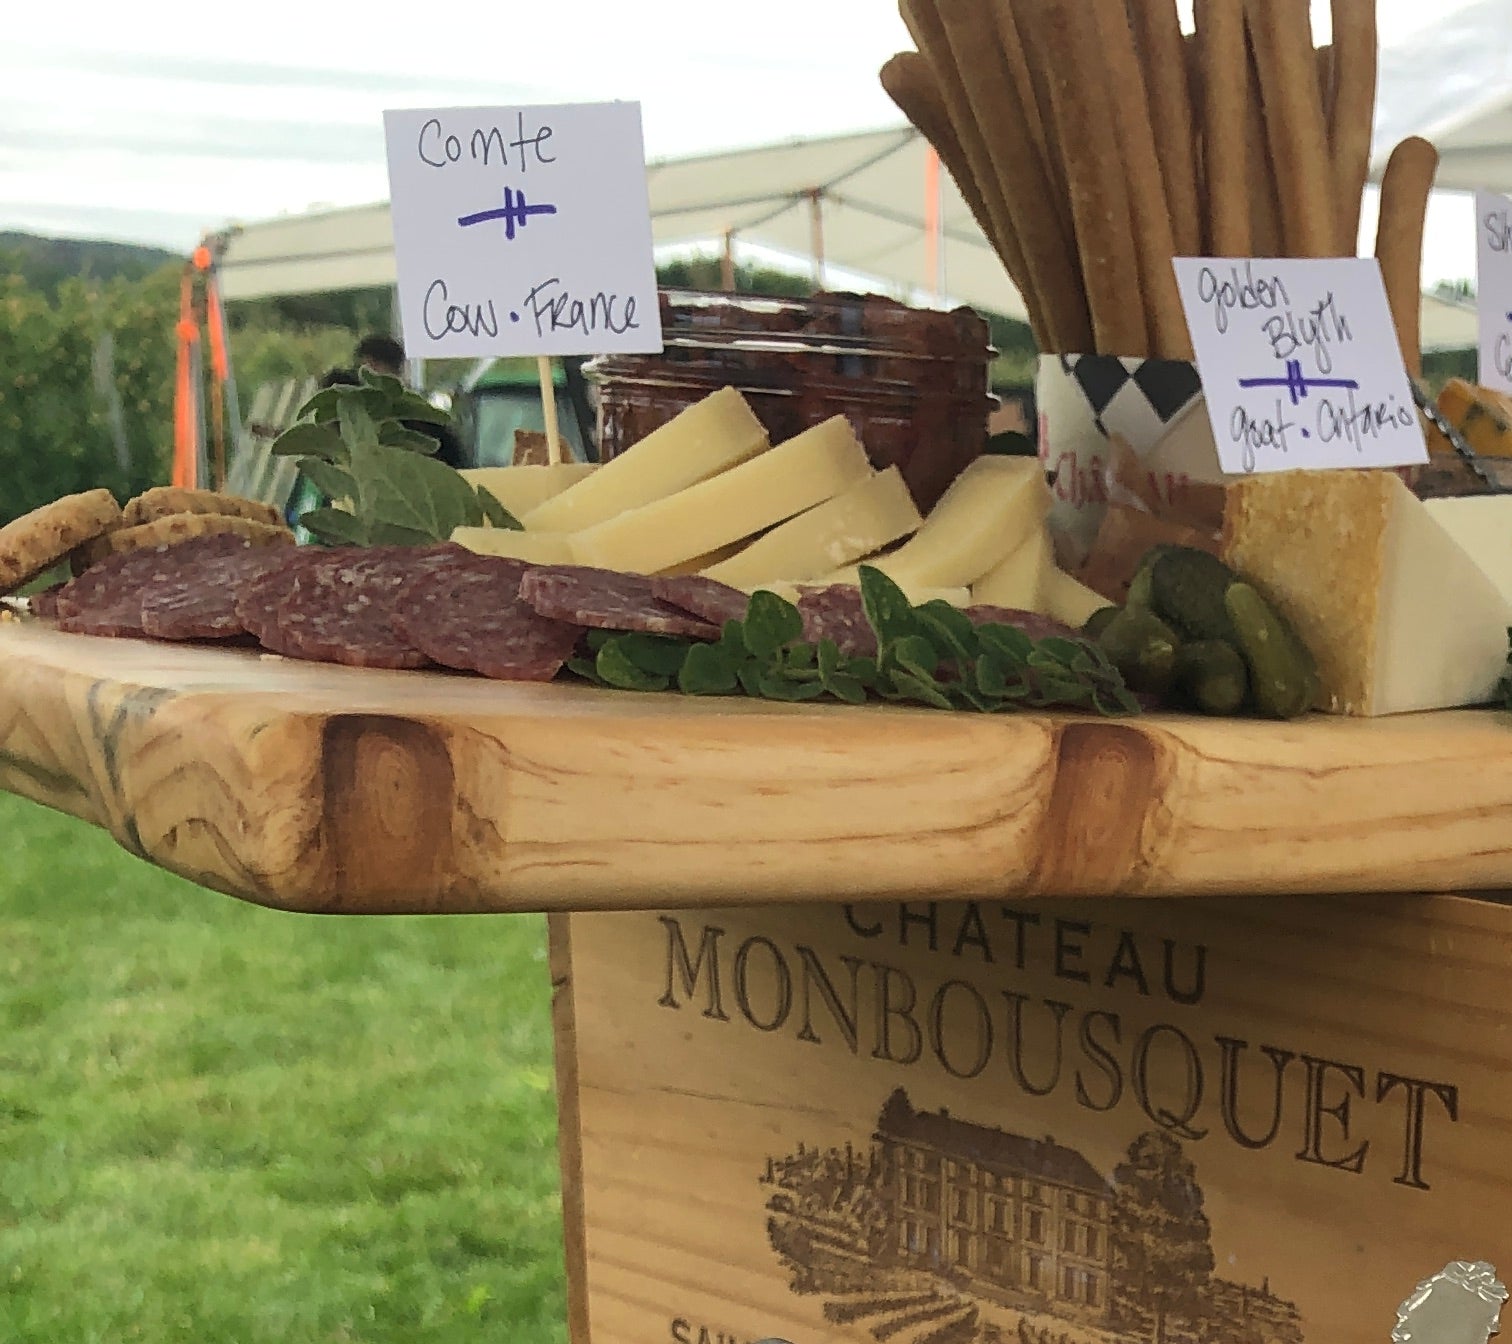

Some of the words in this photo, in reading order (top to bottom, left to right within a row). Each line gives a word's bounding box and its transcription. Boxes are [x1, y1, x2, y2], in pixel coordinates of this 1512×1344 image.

[419, 112, 557, 172] Comte
[424, 279, 498, 340] Cow
[657, 914, 1462, 1192] MONBOUSQUET
